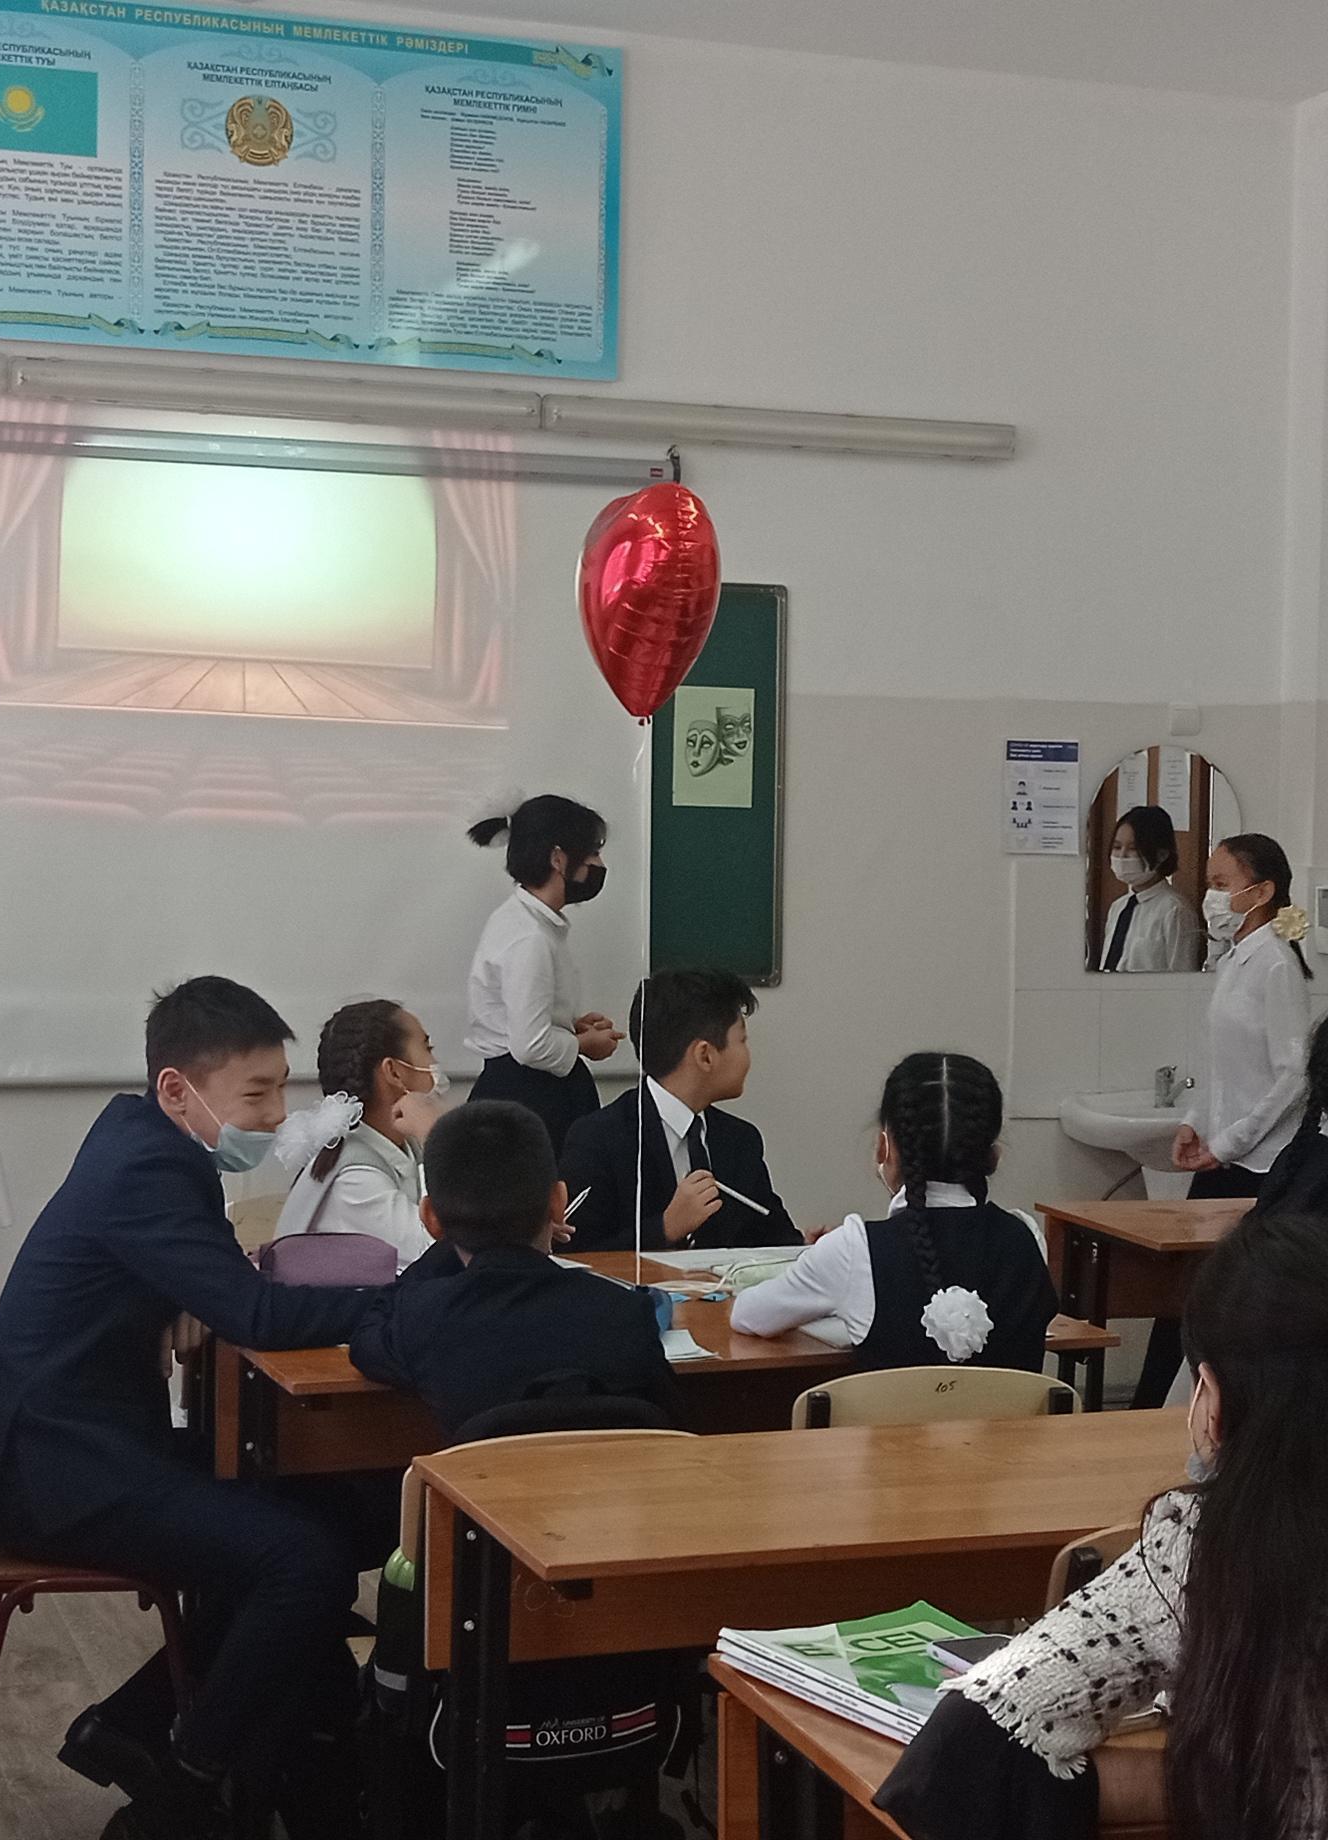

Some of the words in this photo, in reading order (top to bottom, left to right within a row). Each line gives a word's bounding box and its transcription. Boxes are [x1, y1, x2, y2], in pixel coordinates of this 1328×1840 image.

[41, 0, 126, 18] ҚАЗАҚСТАН
[135, 8, 284, 37] РЕСПУБЛИКАСЫНЫҢ
[293, 25, 388, 45] МЕМЛЕКЕТТІК
[396, 36, 469, 54] РӘМІЗДЕРІ
[35, 56, 56, 66] ТУЫ
[187, 61, 239, 75] ҚАЗАҚСТАН
[239, 66, 332, 84] РЕСПУБЛИКАСЫНЫҢ
[425, 85, 474, 98] ҚАЗАҚСТАН
[475, 90, 563, 108] РЕСПУБЛИКАСЫНЫҢ
[934, 1380, 957, 1393] 105
[536, 1725, 608, 1747] OXFORD
